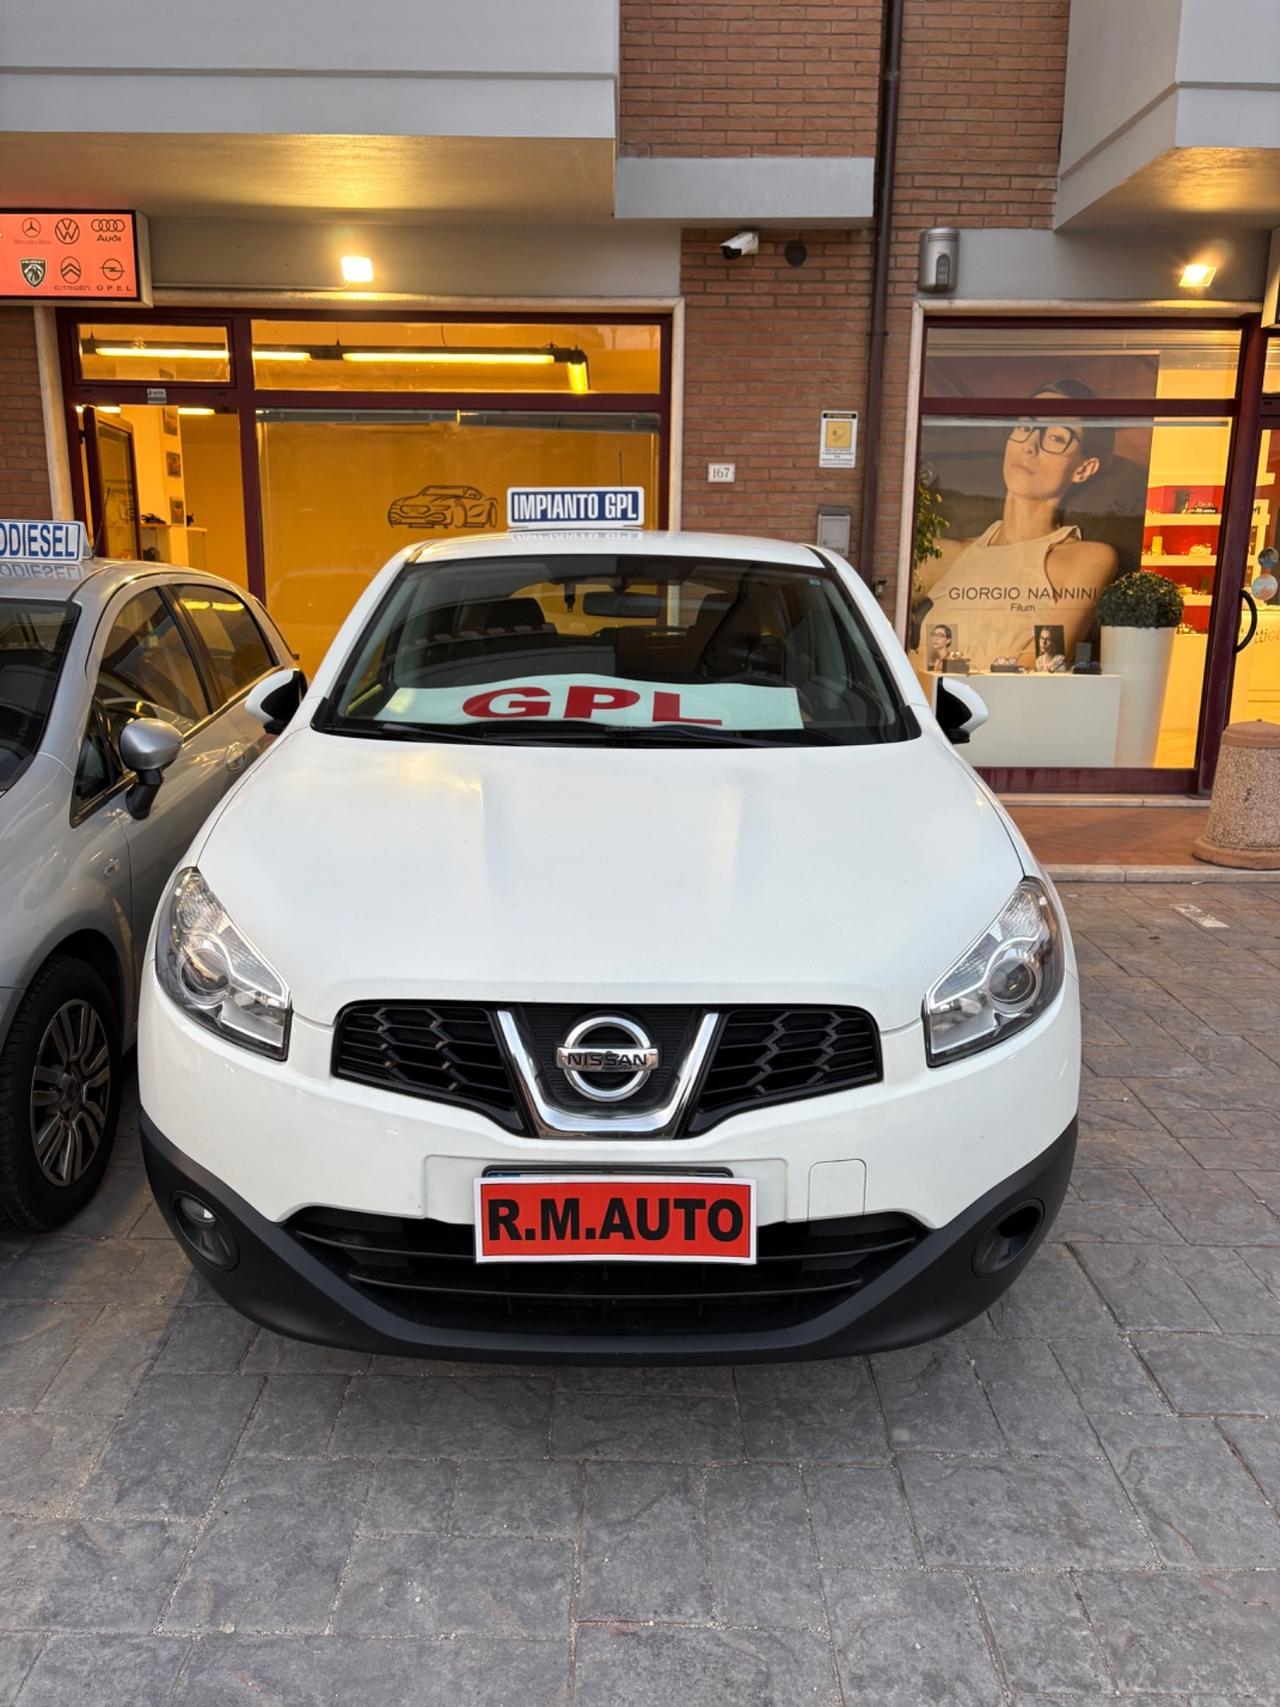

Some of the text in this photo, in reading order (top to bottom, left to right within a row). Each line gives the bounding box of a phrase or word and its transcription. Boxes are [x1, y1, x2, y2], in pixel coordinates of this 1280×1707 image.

[96, 234, 122, 242] Audi
[712, 466, 730, 479] 167
[513, 493, 637, 520] IMPIANTO GPL
[948, 587, 1097, 600] GIORGIO NANNINI
[1010, 603, 1036, 612] Filum
[462, 685, 722, 726] GPL
[567, 1053, 648, 1066] NISSAN
[488, 1197, 744, 1242] R.M.AUTO
